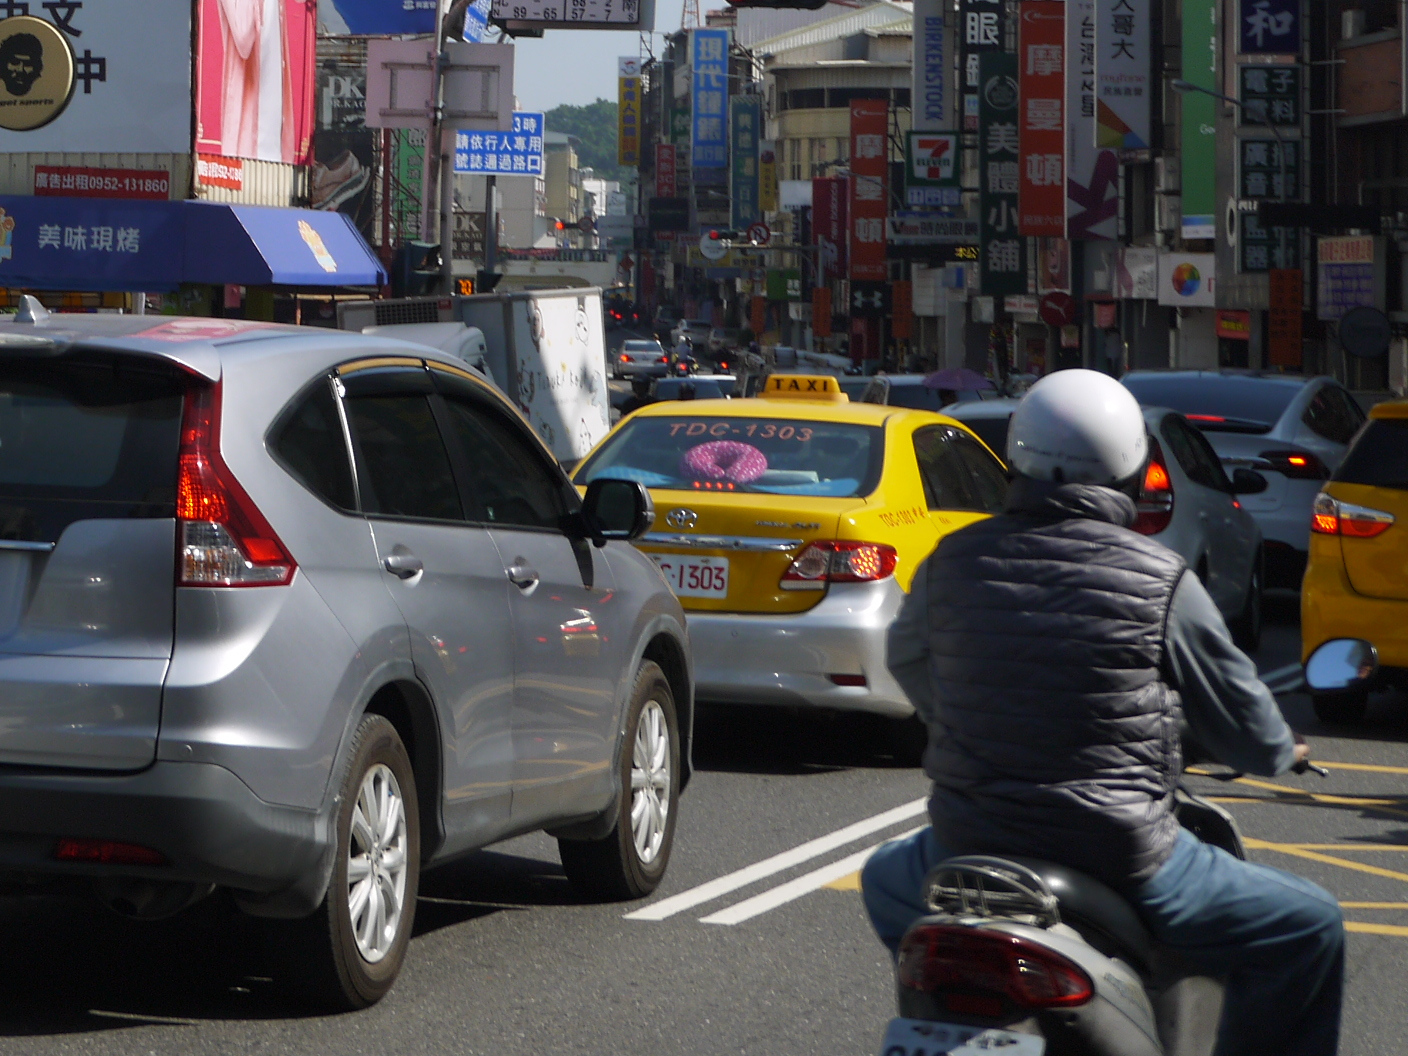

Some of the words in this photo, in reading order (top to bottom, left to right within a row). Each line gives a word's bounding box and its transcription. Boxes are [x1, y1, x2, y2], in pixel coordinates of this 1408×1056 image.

[543, 7, 557, 20] 65
[571, 7, 586, 20] 57
[604, 9, 612, 21] 7
[924, 16, 944, 122] BIRKENSTOCK
[1026, 44, 1063, 186] 摩曼頓
[456, 135, 542, 152] 請依行人專用
[37, 224, 141, 254] 美味現烤
[773, 378, 829, 392] TAXI
[669, 422, 813, 442] TDC-1303
